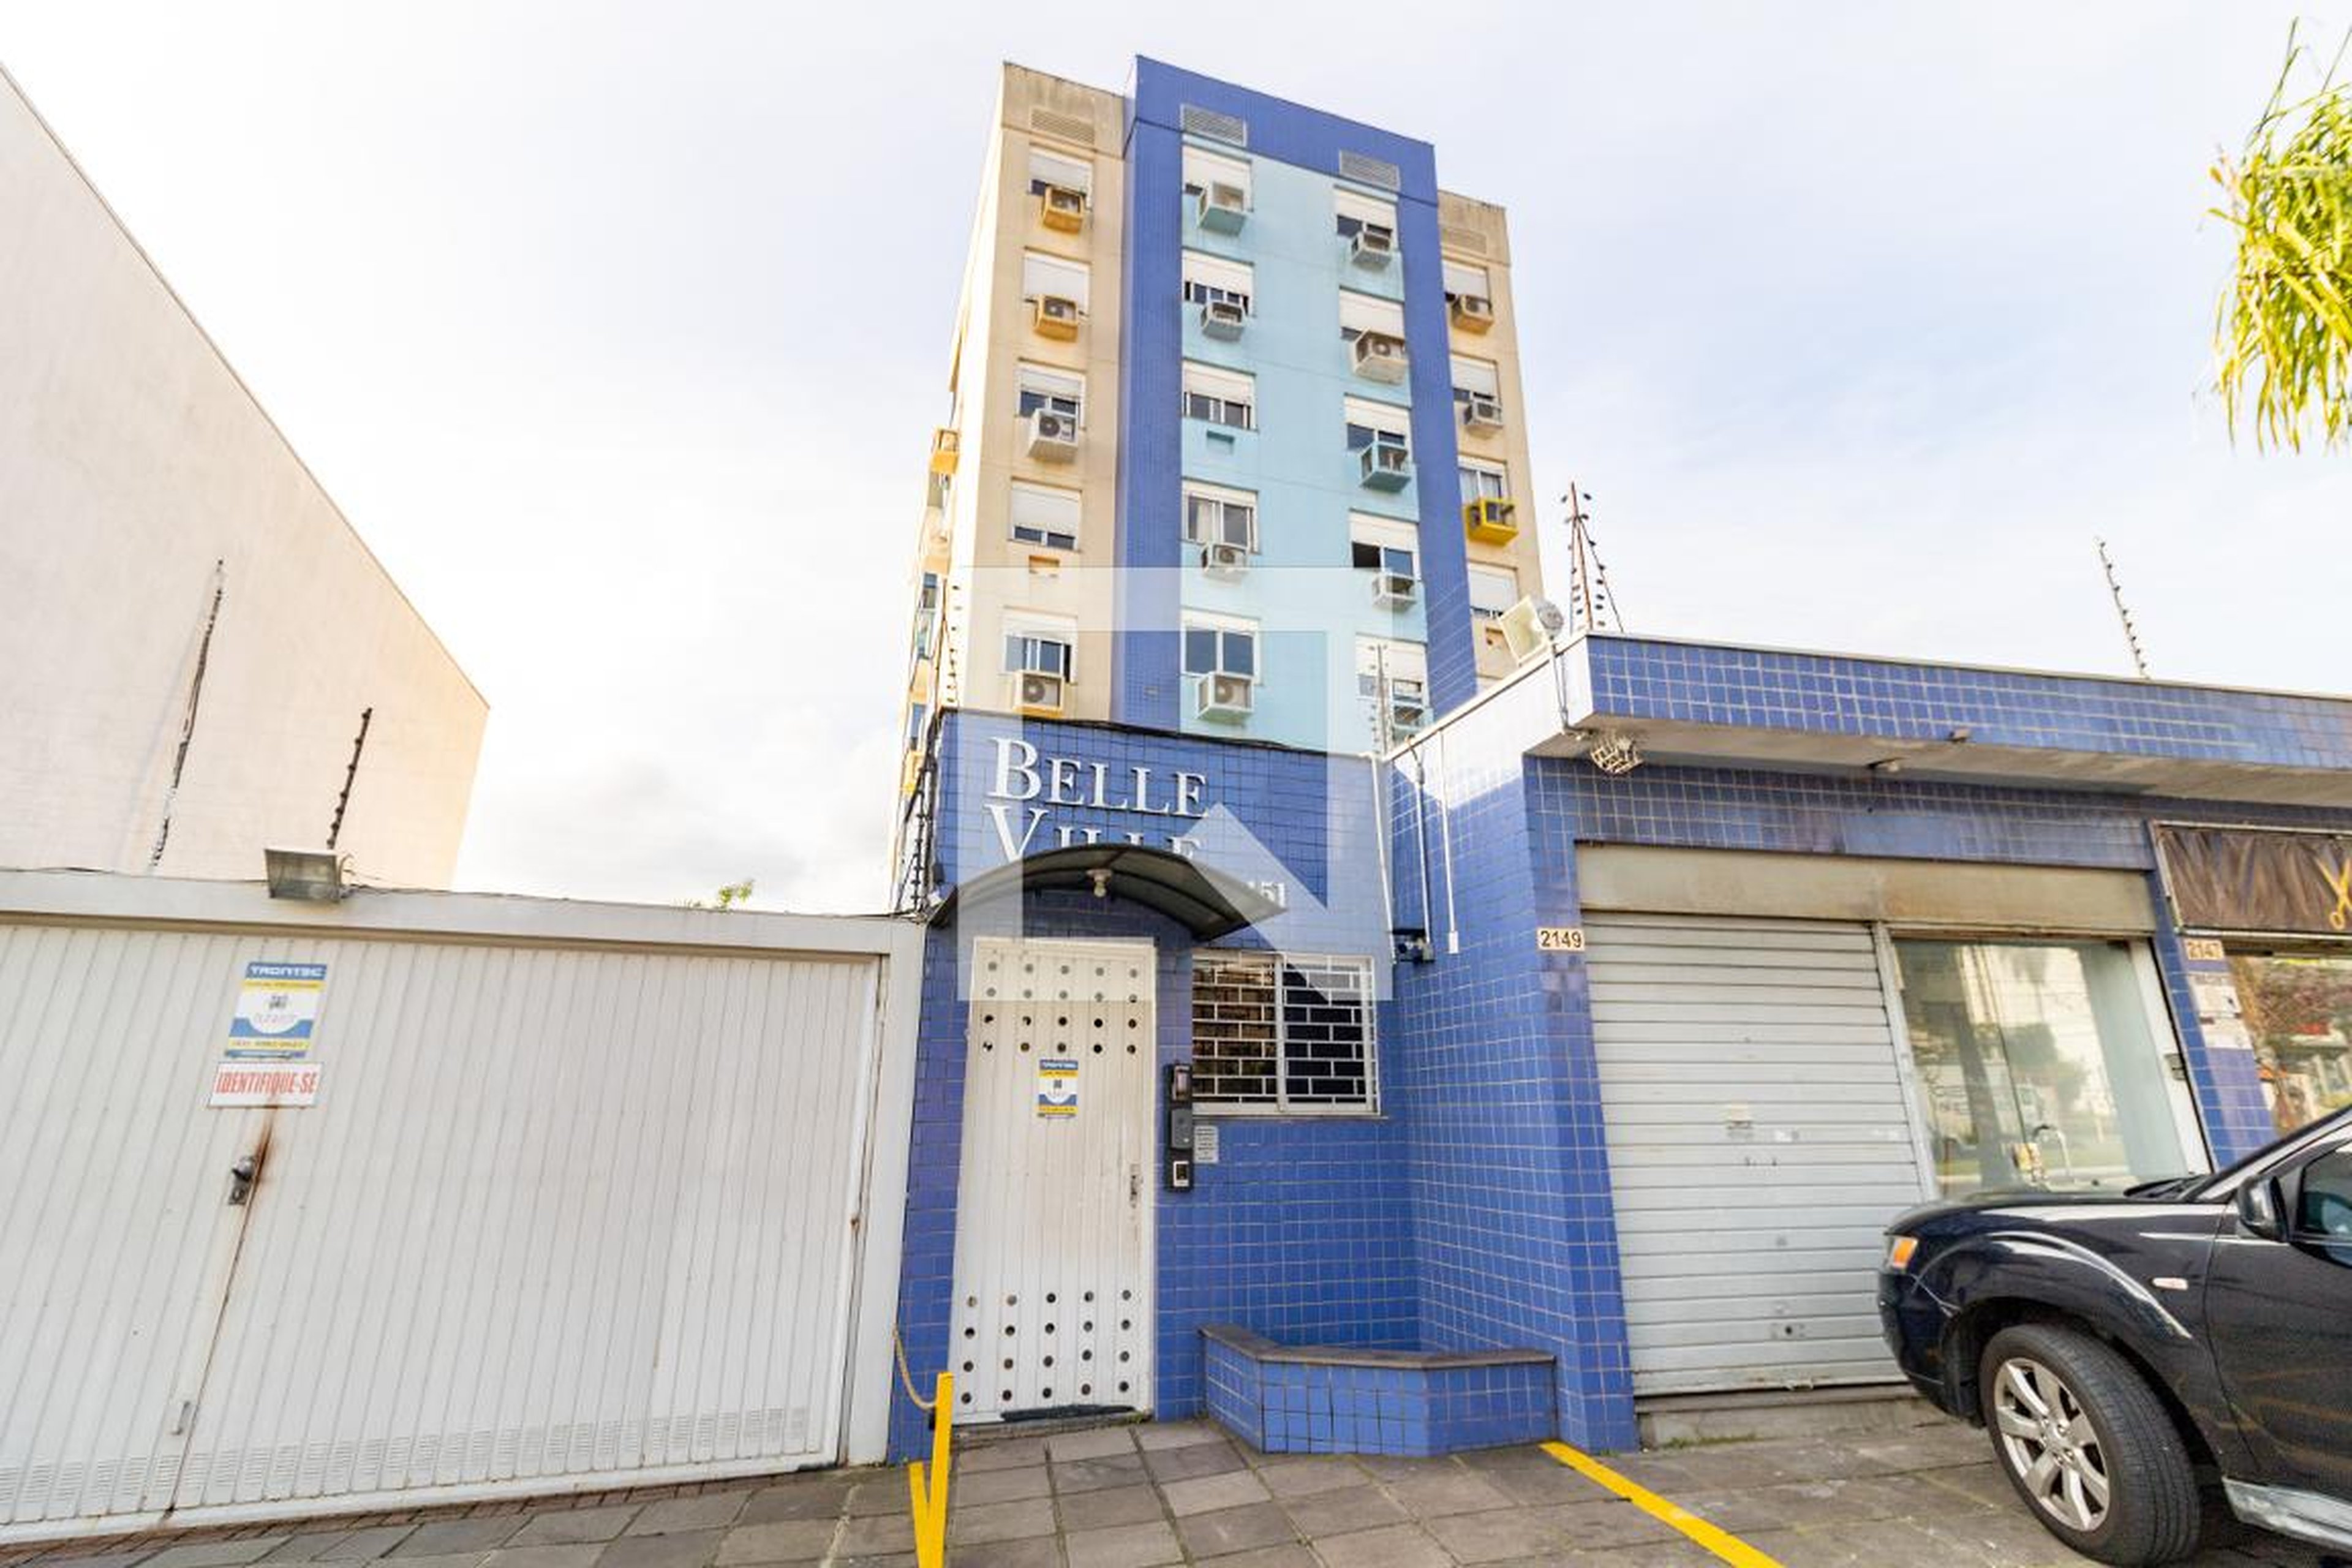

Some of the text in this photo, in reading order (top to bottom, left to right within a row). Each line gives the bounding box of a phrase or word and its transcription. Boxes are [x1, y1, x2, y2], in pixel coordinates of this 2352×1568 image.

[988, 737, 1208, 818] BELLE
[1247, 881, 1285, 908] 51
[1540, 930, 1581, 948] 2149
[216, 1071, 317, 1095] IDENTIFIQUE-SE
